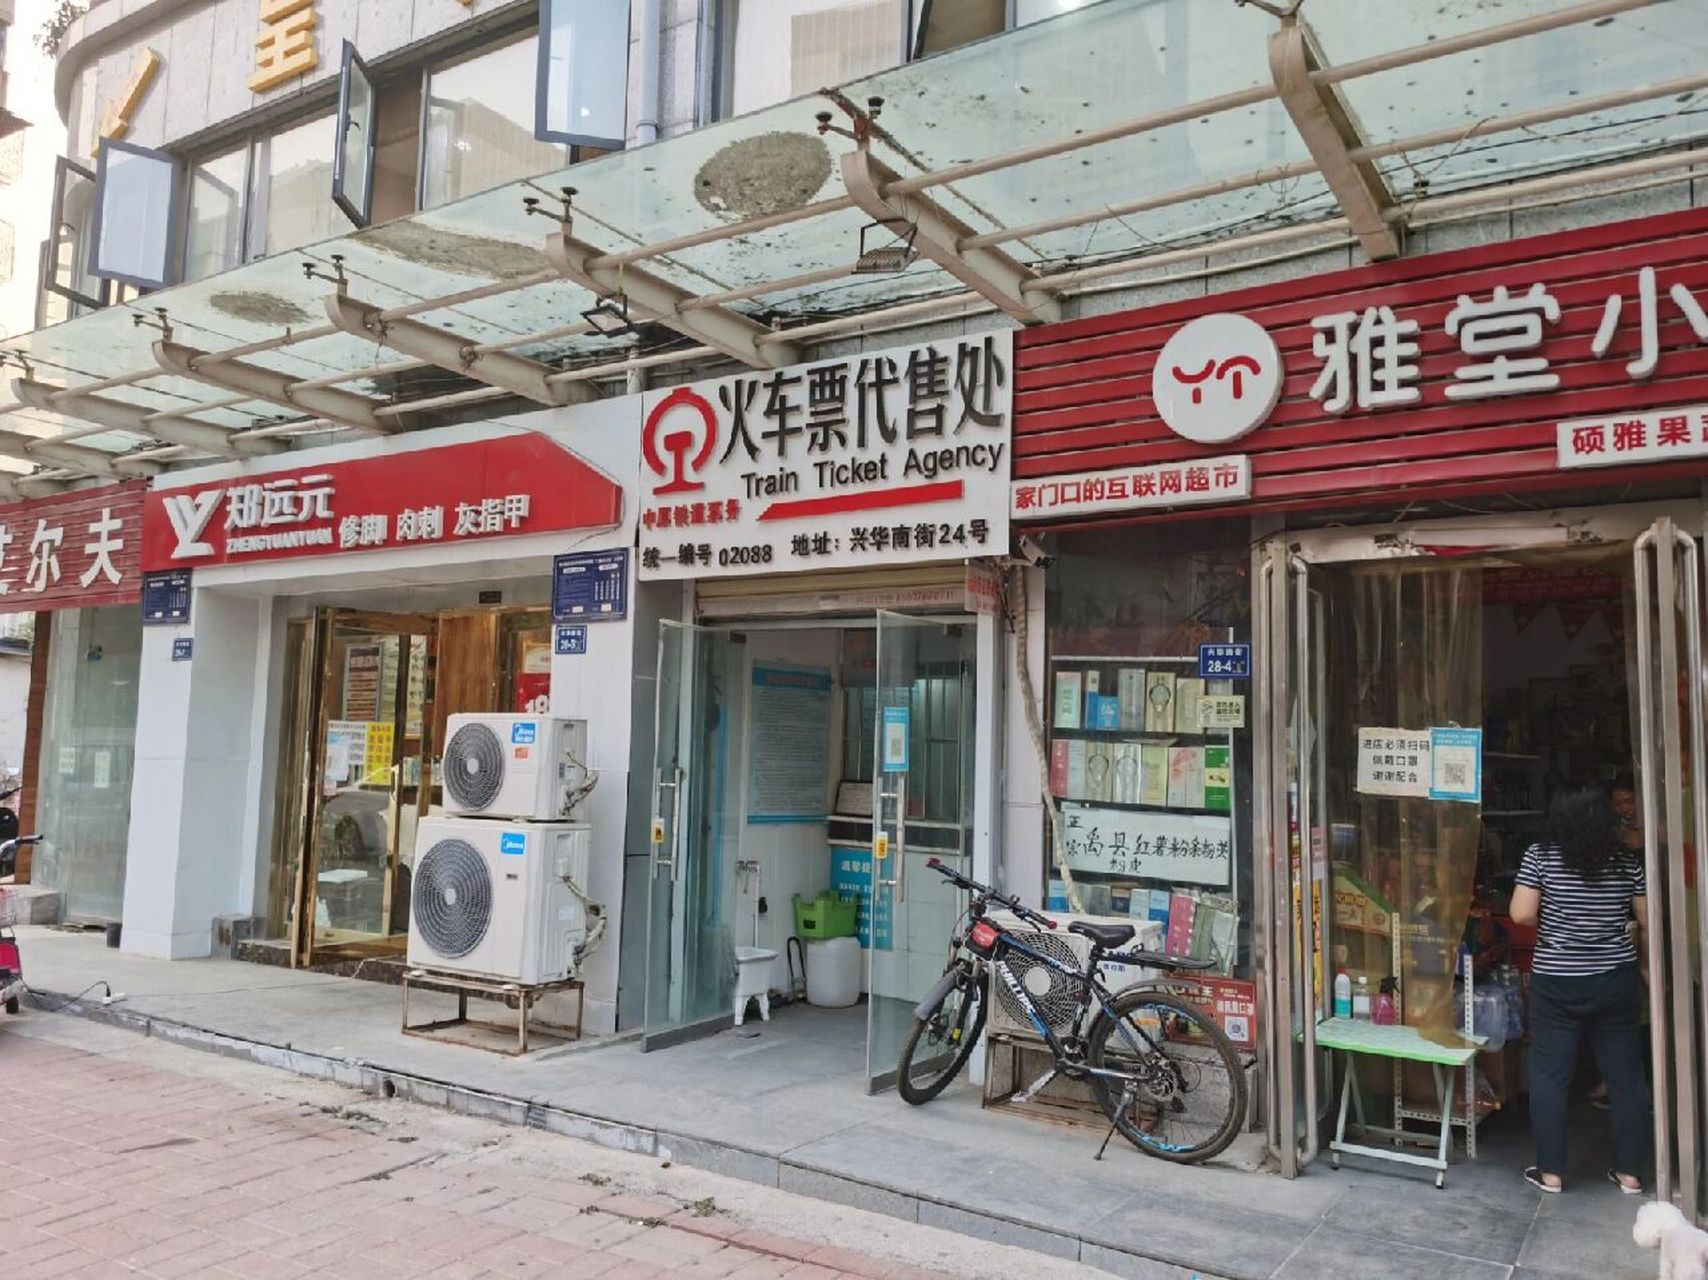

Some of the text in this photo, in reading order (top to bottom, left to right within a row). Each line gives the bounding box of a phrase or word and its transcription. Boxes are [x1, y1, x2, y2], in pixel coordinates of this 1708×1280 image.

[1310, 266, 1708, 415] 雅堂小
[719, 336, 1006, 465] 火车票代售处
[741, 442, 1004, 499] Train Ticket Agency
[1015, 463, 1239, 510] 家门口的互联网超市
[224, 474, 336, 529] 郑远元
[338, 494, 531, 548] 修脚 肉刺 灰指甲
[1362, 738, 1430, 752] 进店必须扫码
[1372, 770, 1418, 783] 谢谢配合
